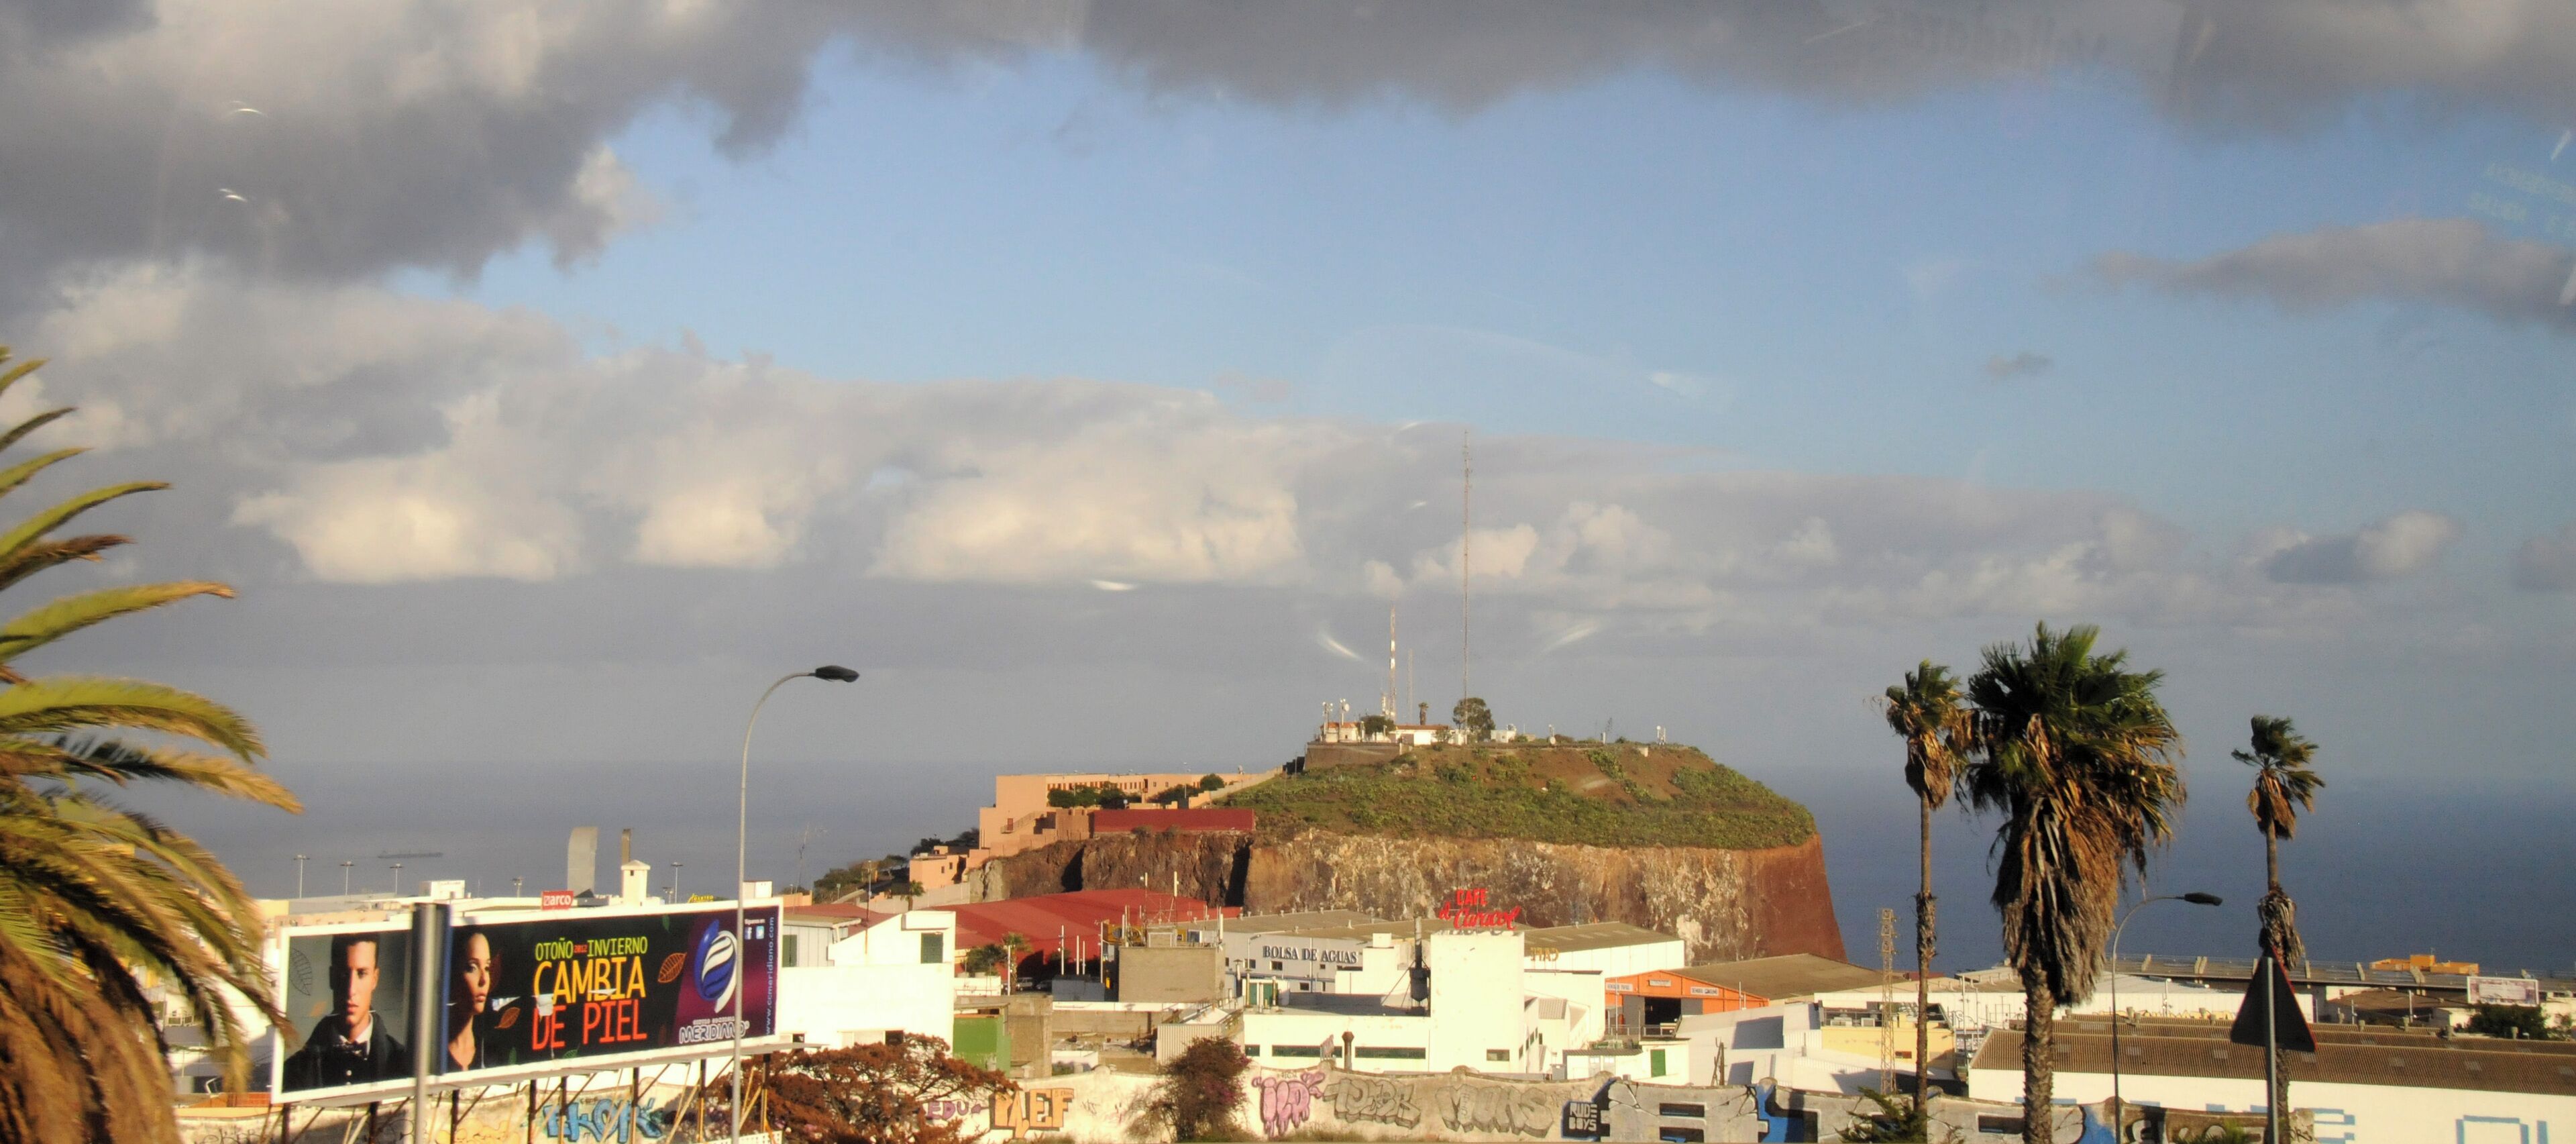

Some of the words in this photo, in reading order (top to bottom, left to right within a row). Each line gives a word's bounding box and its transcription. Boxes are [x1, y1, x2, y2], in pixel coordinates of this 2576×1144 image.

[1456, 888, 1488, 905] CAFE
[1454, 905, 1521, 930] Caracol
[535, 937, 573, 961] OTOÑO
[574, 944, 588, 953] 2012
[587, 936, 648, 957] INVIERNO
[1263, 945, 1299, 960] BOLSA
[1301, 948, 1318, 961] DE
[1320, 950, 1357, 964] AGUAS
[533, 956, 646, 1004] CAMBIA
[532, 1004, 567, 1051] DE
[582, 998, 647, 1045] PIEL
[1570, 1102, 1597, 1116] RUDE
[1569, 1118, 1597, 1131] BOYS
